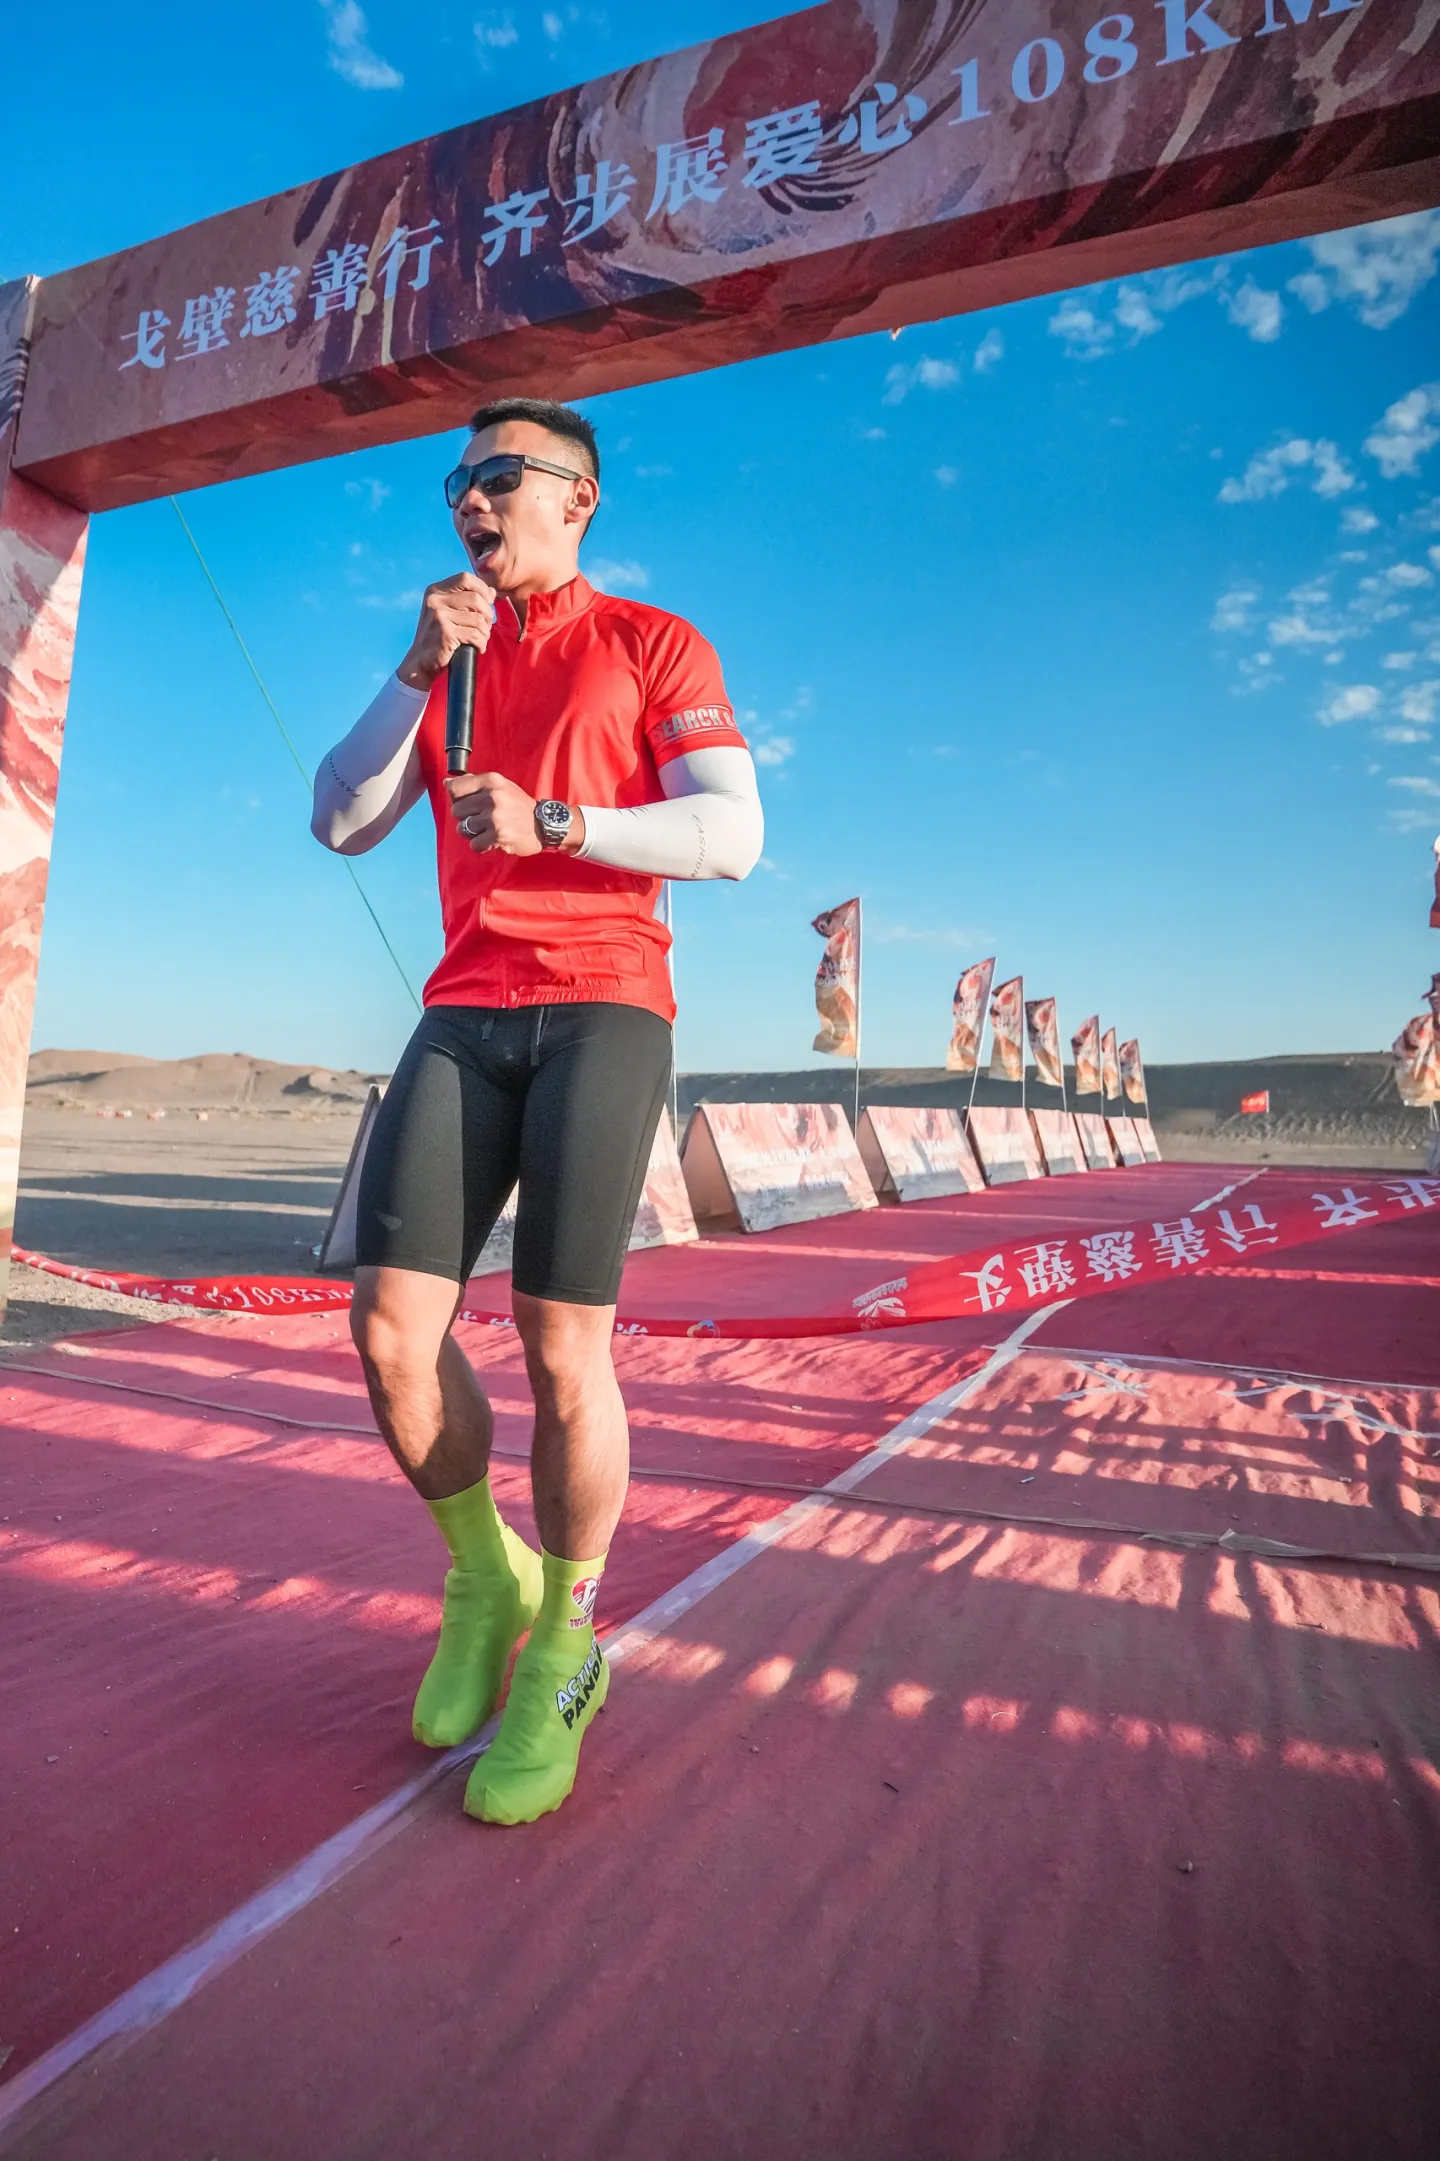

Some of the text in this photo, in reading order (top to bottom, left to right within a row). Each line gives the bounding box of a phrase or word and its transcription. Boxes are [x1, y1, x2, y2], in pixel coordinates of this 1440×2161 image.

[118, 217, 445, 371] 戈壁慈善行
[691, 813, 706, 878] FASHION
